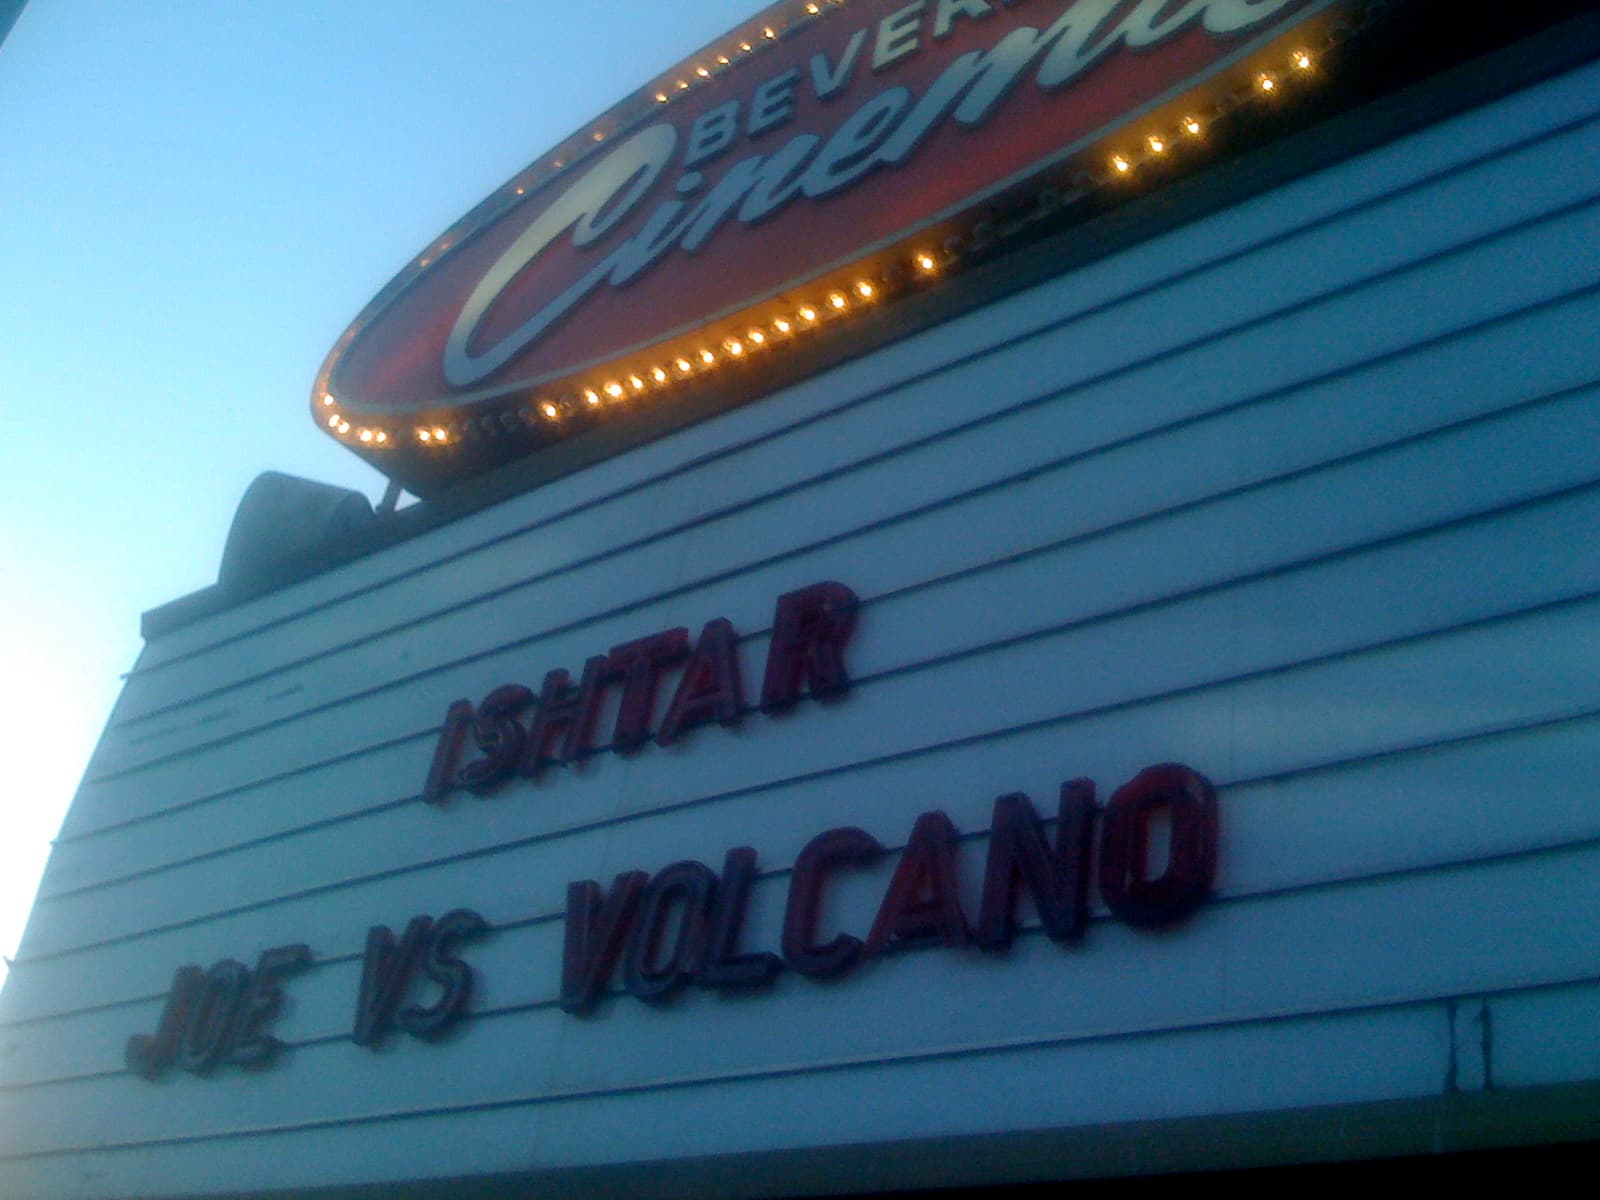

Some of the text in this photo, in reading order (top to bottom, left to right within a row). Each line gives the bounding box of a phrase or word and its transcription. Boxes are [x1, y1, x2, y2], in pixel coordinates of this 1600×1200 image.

[424, 580, 859, 803] ISHTAR
[125, 762, 1219, 1080] JOE VS VOLCANO
